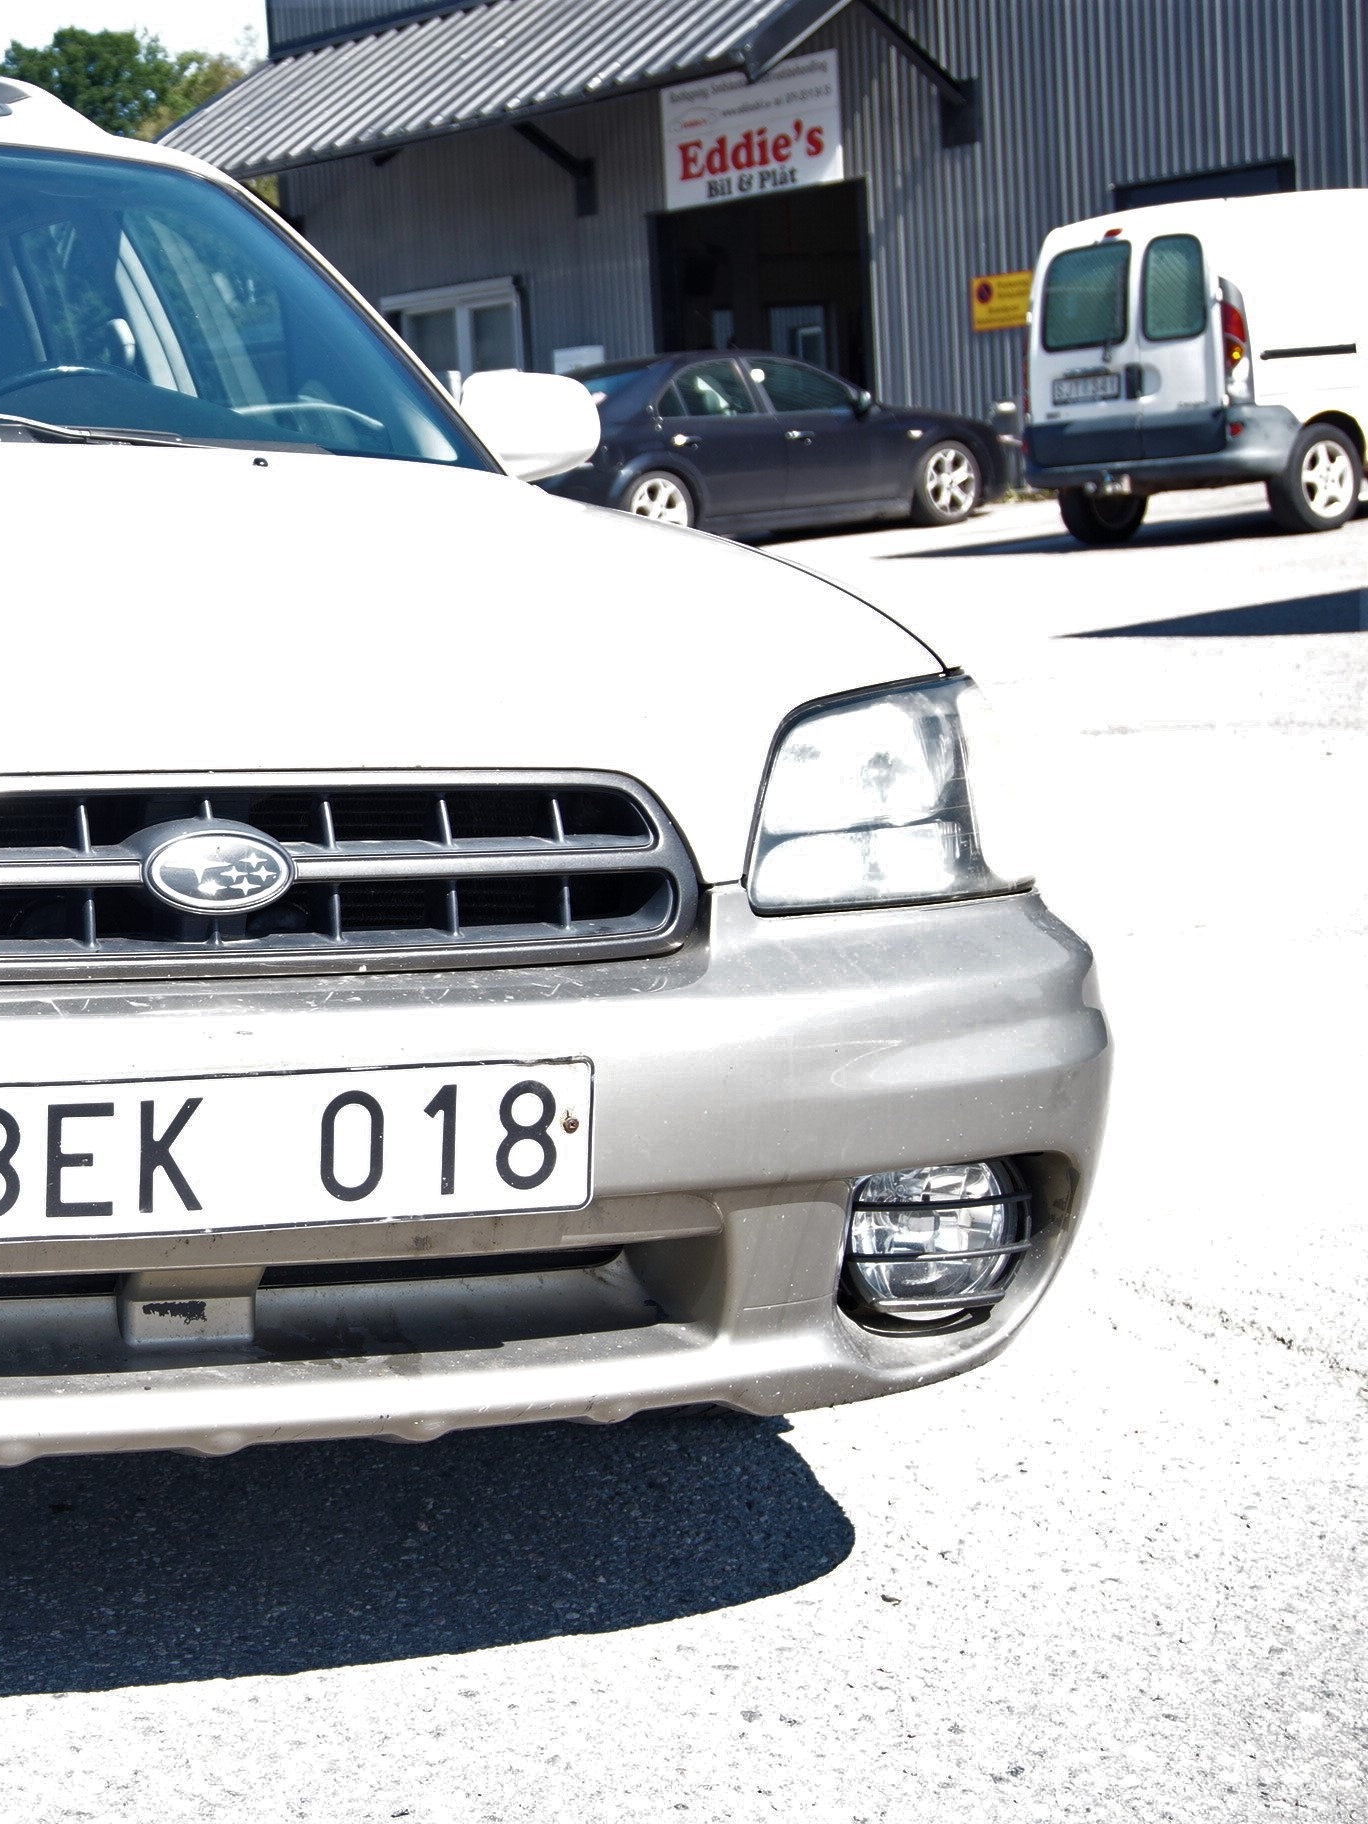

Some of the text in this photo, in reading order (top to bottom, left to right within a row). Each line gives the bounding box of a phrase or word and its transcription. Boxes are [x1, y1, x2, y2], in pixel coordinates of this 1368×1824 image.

[678, 118, 825, 181] Eddie's
[706, 164, 798, 199] Bil & Plåt
[320, 1080, 558, 1202] 018
